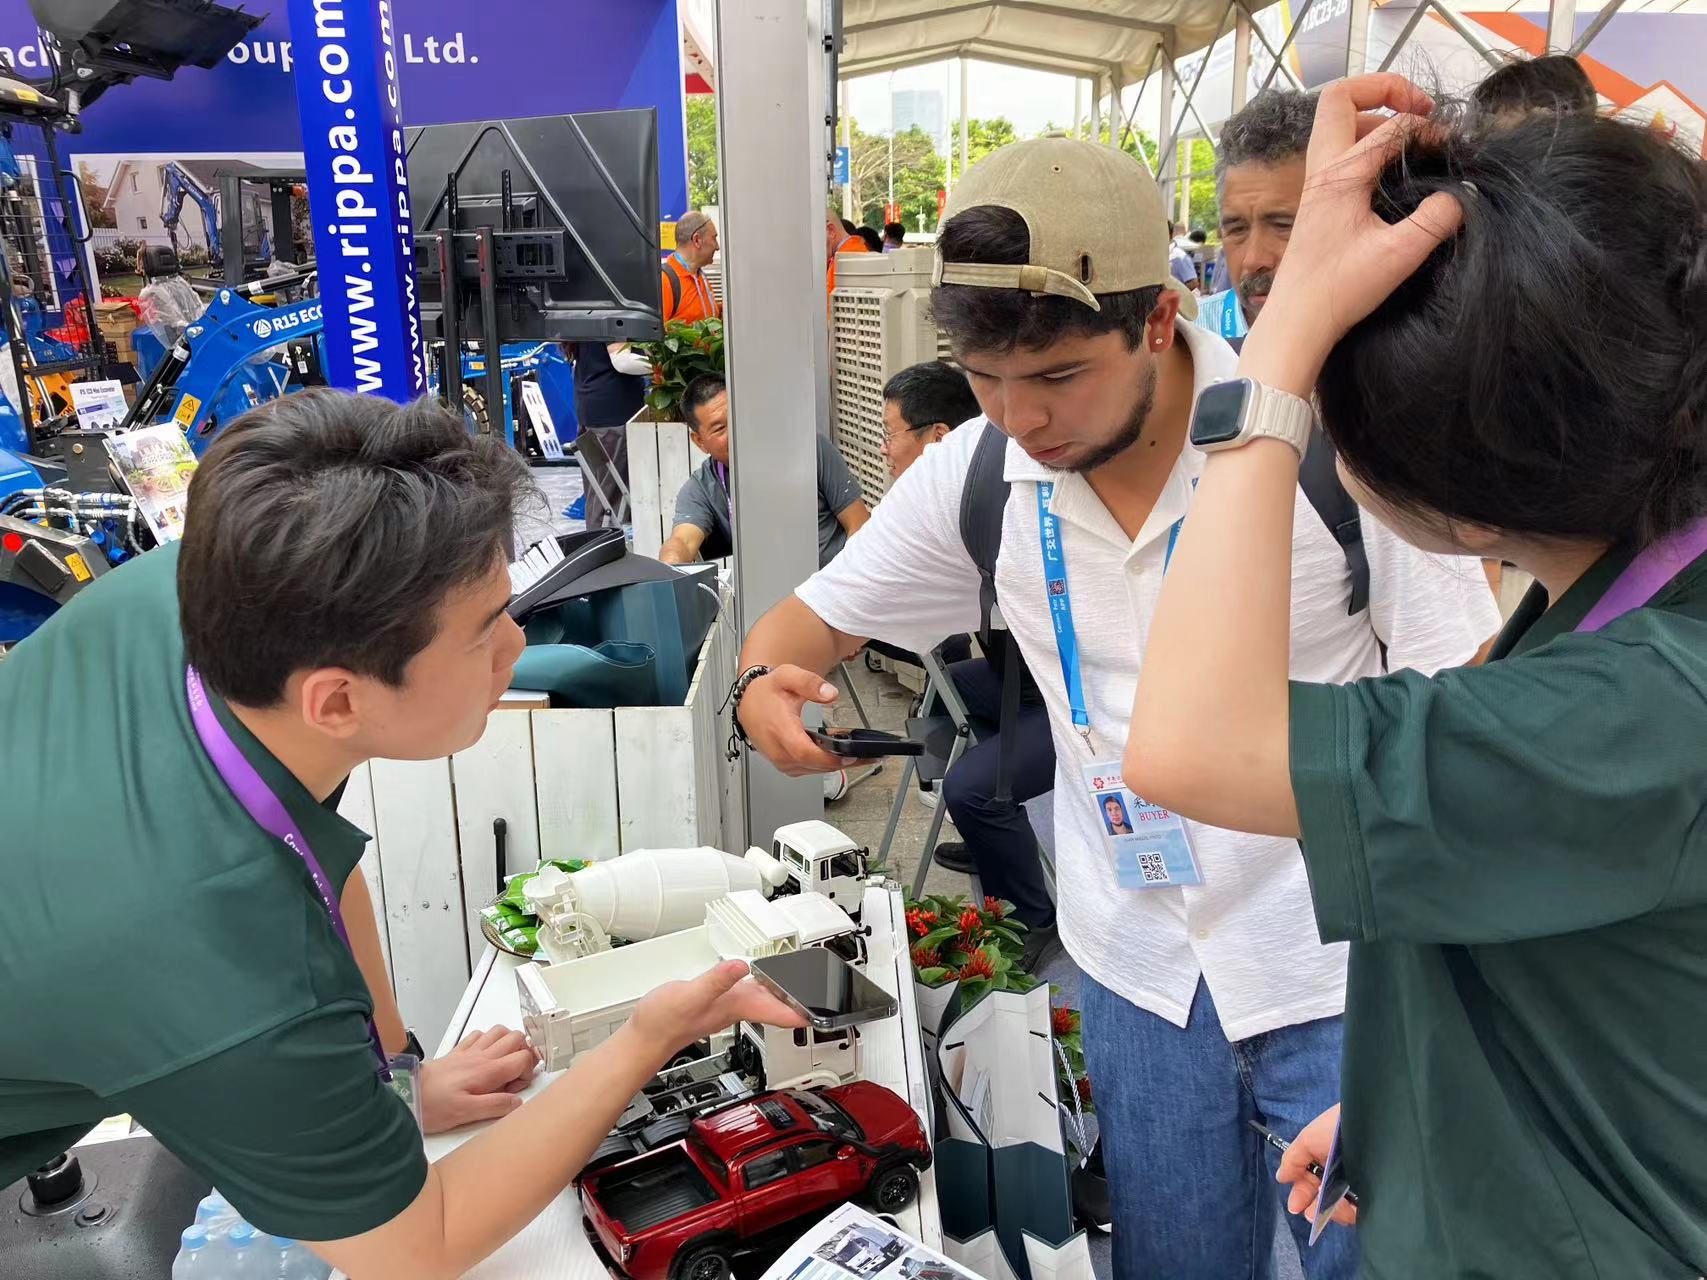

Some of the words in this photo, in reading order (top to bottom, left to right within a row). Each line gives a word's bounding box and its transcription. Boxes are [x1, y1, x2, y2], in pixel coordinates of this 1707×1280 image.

[228, 41, 293, 72] oup
[403, 32, 479, 63] Ltd.
[312, 0, 384, 393] www.rippa.com
[379, 1, 424, 390] www.rippa.com
[272, 312, 299, 331] R15
[1043, 516, 1058, 561] 广交世界
[1139, 809, 1170, 822] BUYER
